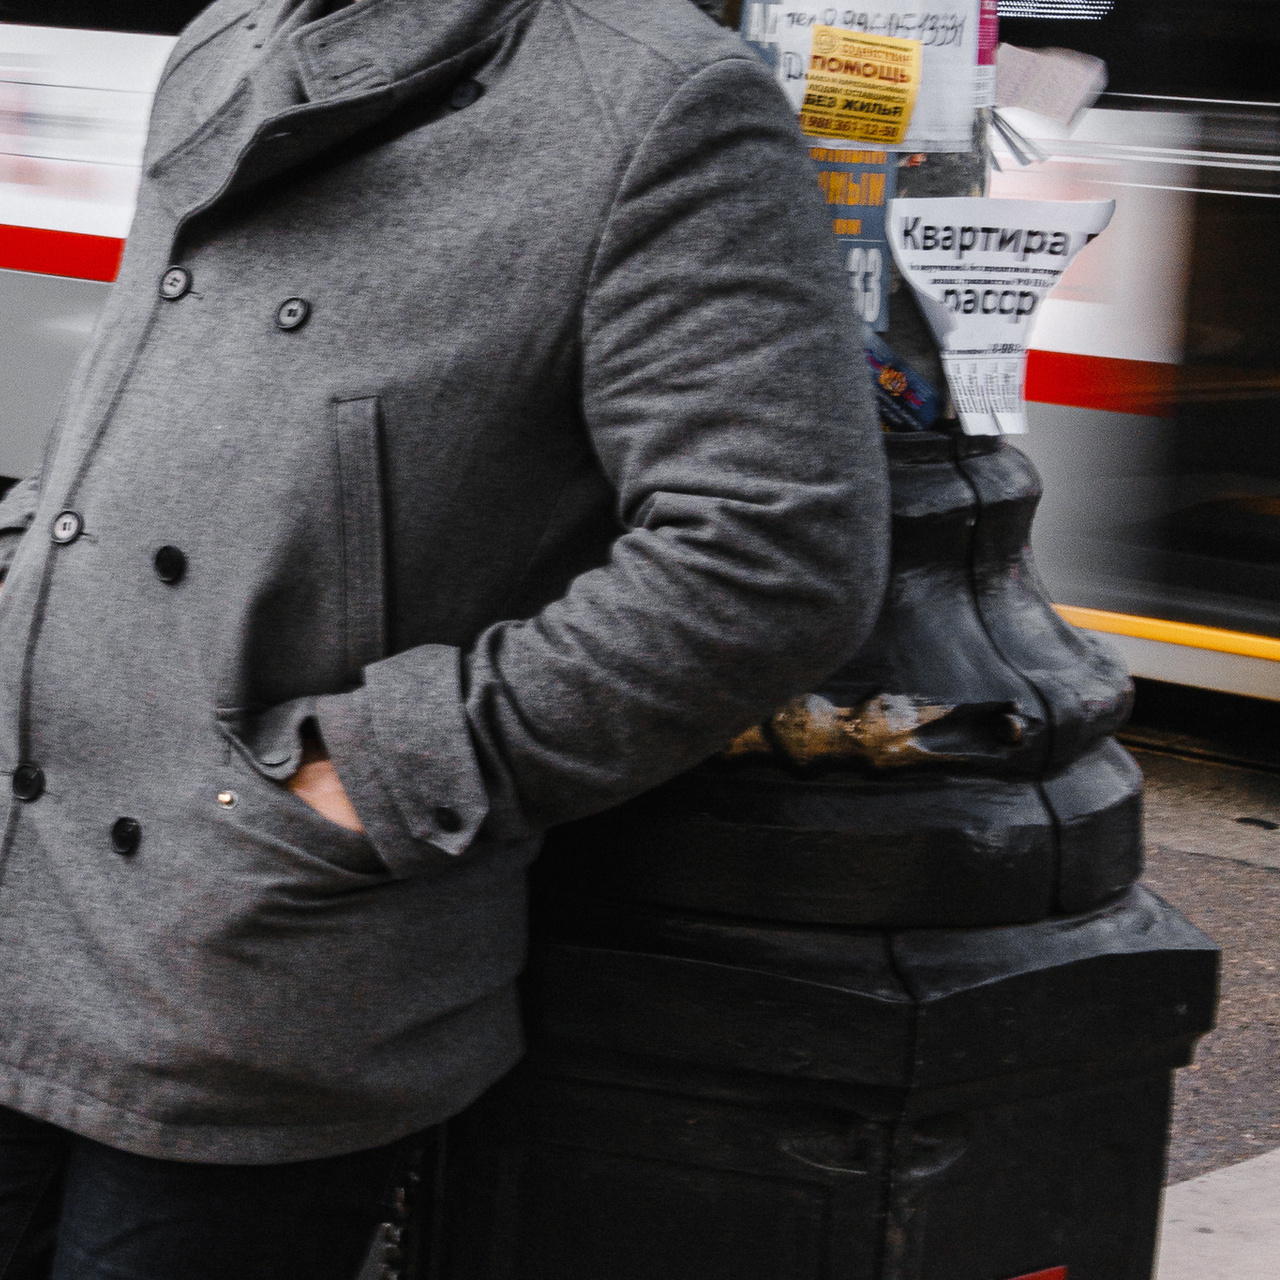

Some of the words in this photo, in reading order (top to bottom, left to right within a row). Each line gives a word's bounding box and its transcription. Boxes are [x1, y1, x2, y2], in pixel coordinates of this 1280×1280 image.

[810, 54, 911, 84] ПОМОЩЬ
[840, 99, 904, 117] ЖИЛЬЯ
[900, 217, 1071, 261] Квартира
